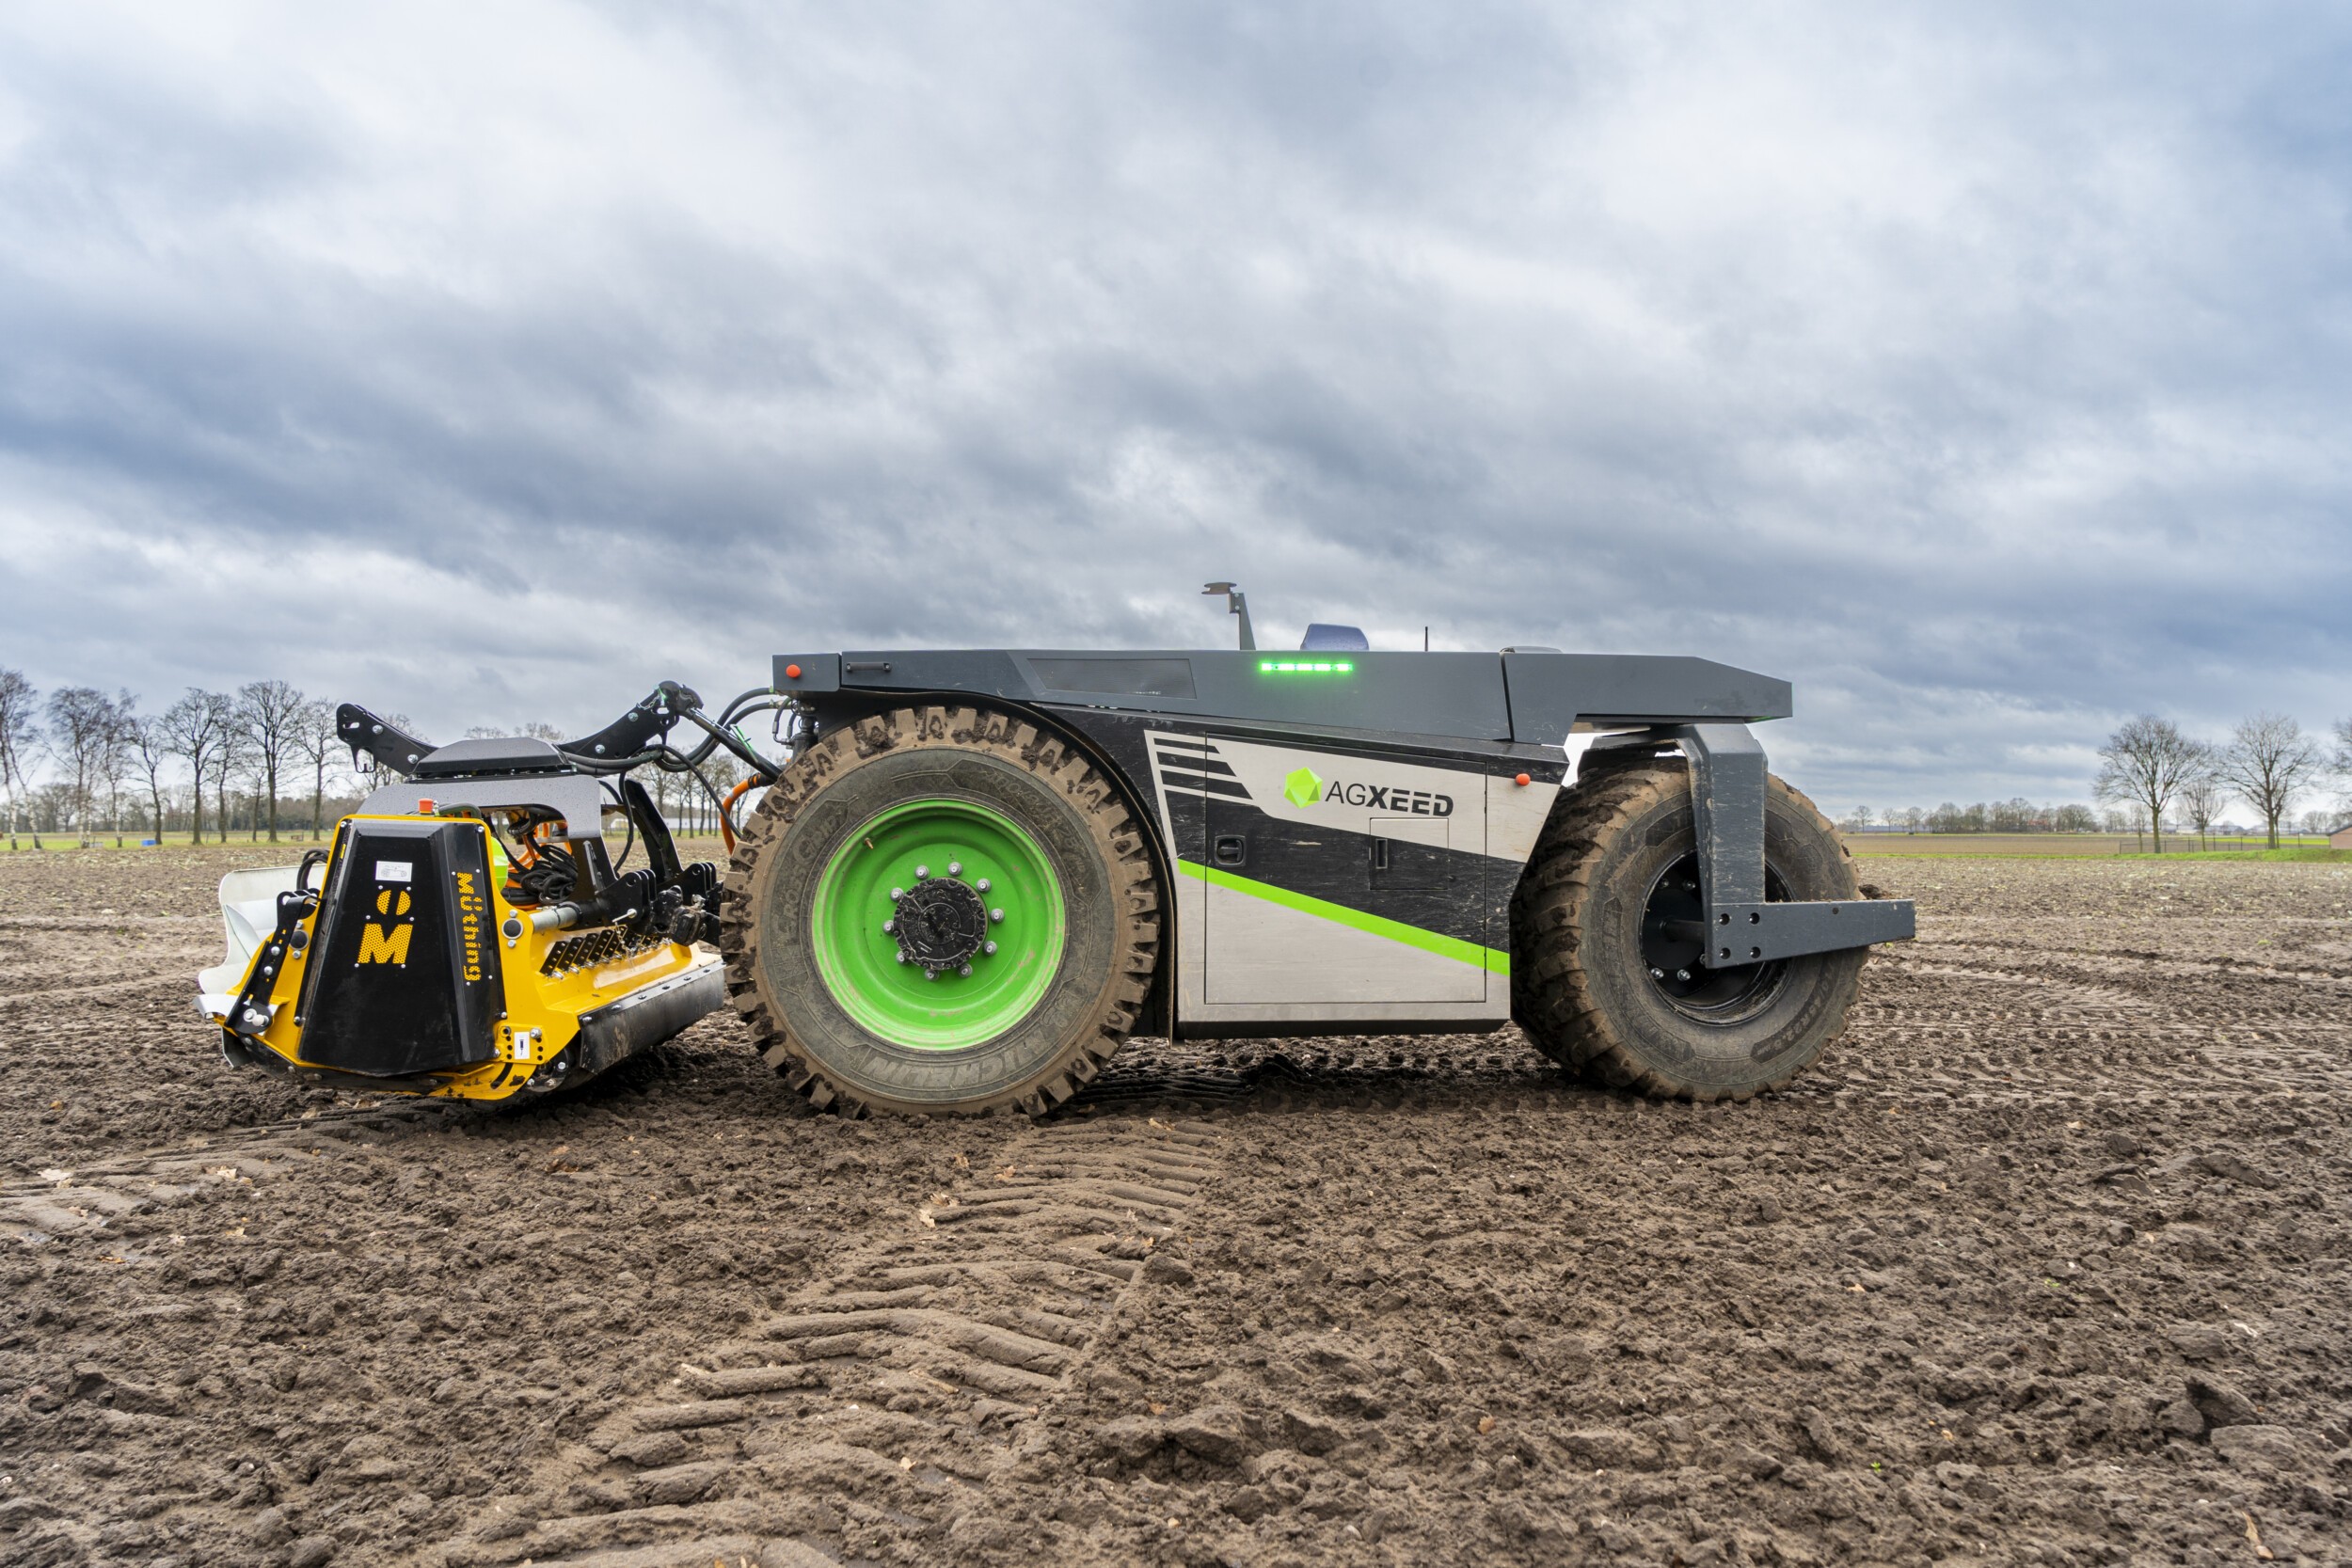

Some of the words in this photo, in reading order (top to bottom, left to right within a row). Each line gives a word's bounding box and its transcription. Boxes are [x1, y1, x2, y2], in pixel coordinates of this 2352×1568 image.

[1325, 781, 1454, 816] AGXEED
[456, 872, 483, 981] Müthing
[864, 1029, 1047, 1086] MICHELIN
